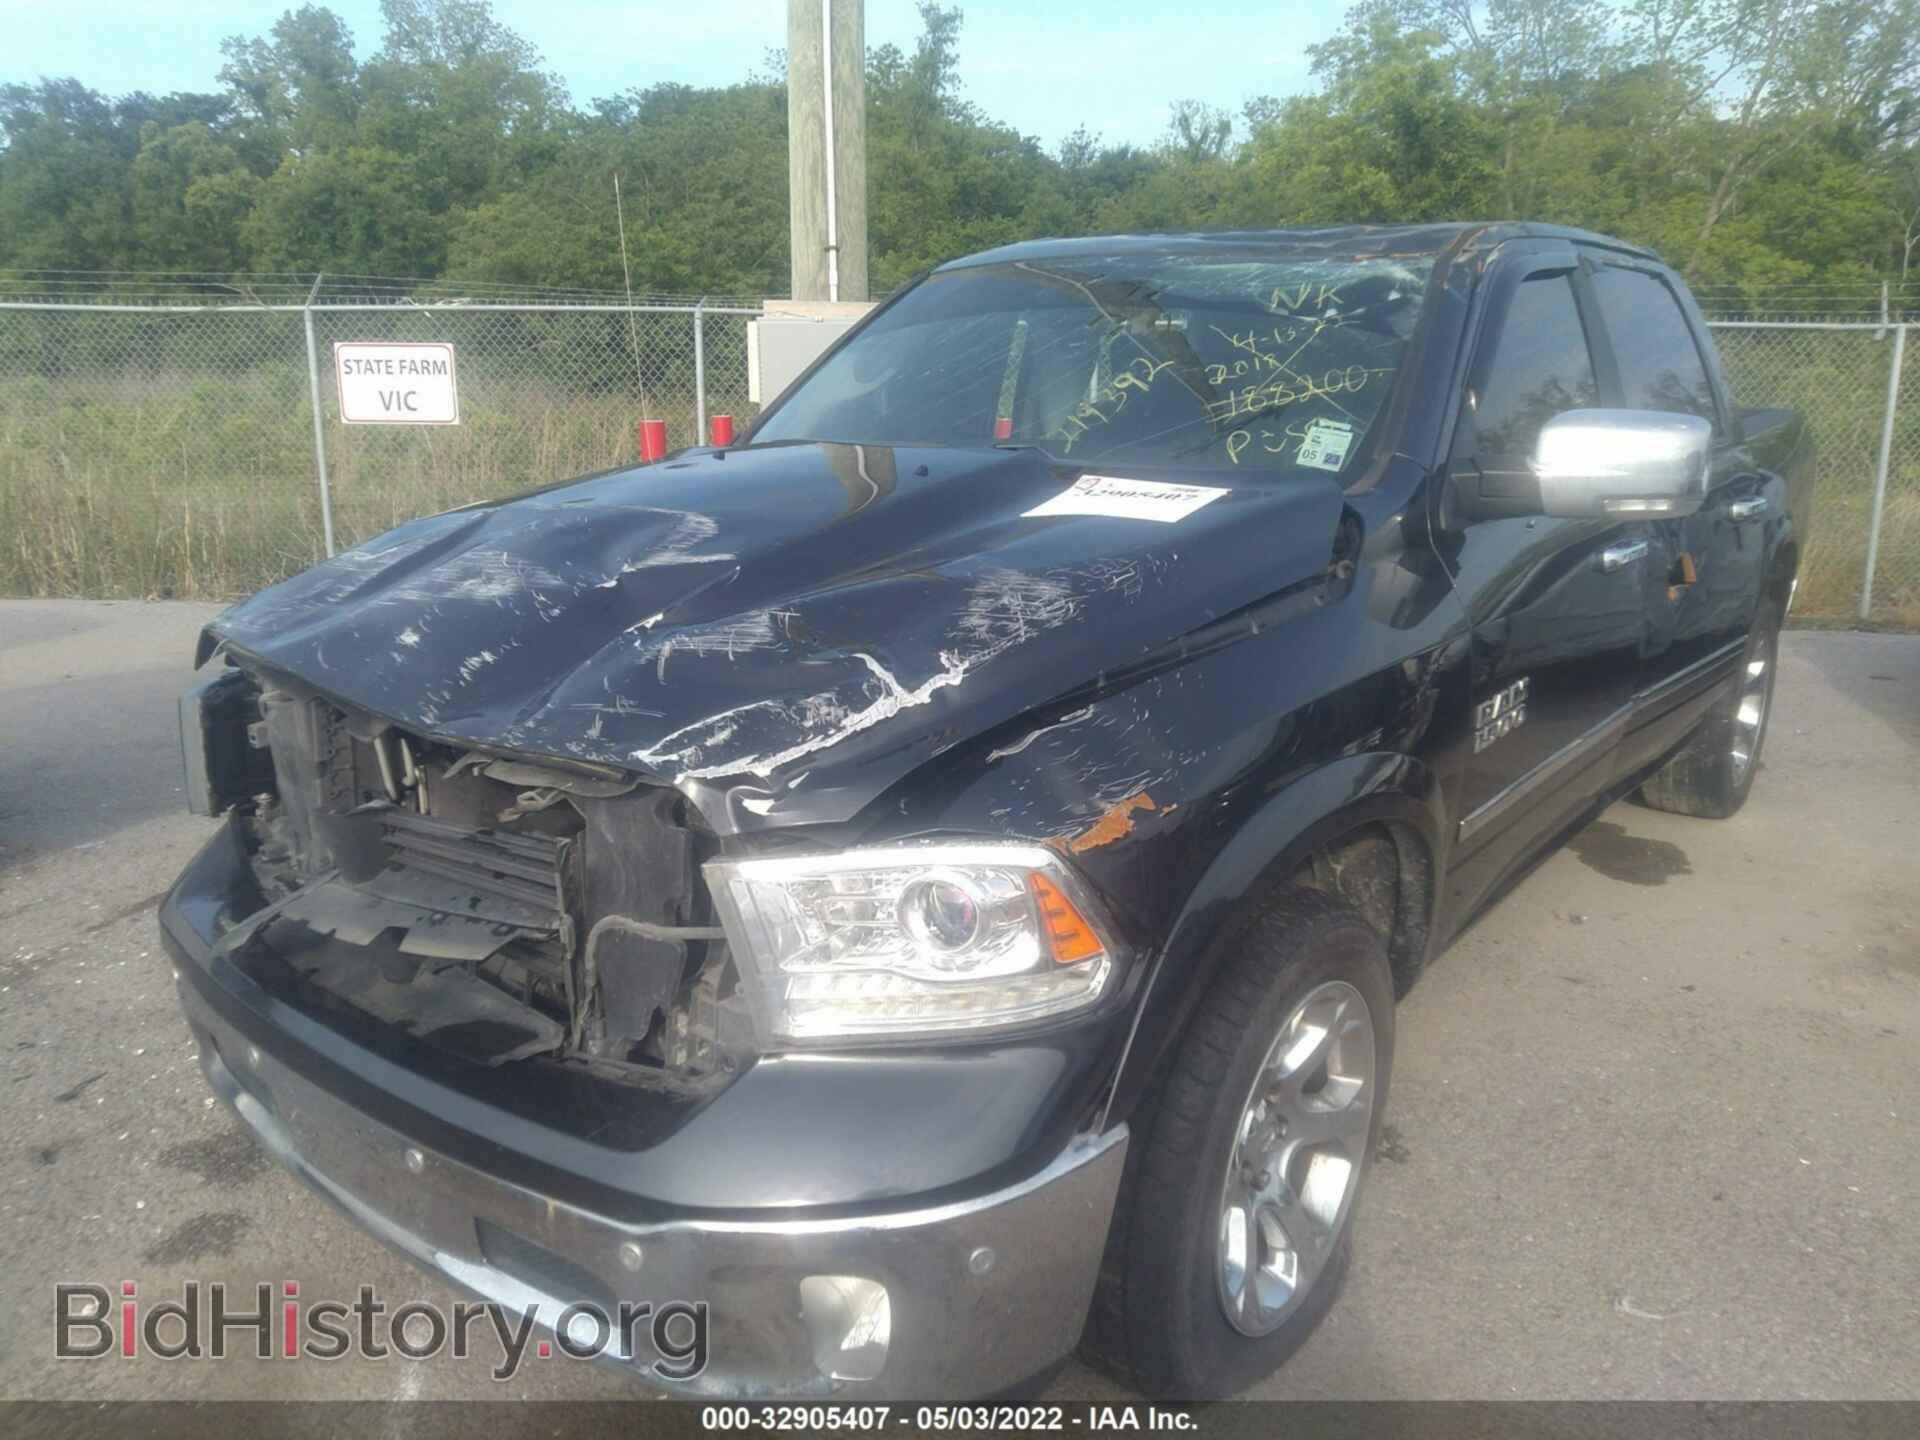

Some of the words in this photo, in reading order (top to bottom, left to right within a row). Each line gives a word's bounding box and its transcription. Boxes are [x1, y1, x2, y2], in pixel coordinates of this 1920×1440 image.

[343, 358, 394, 375] STATE
[400, 359, 448, 375] FARM
[378, 390, 418, 412] VIC
